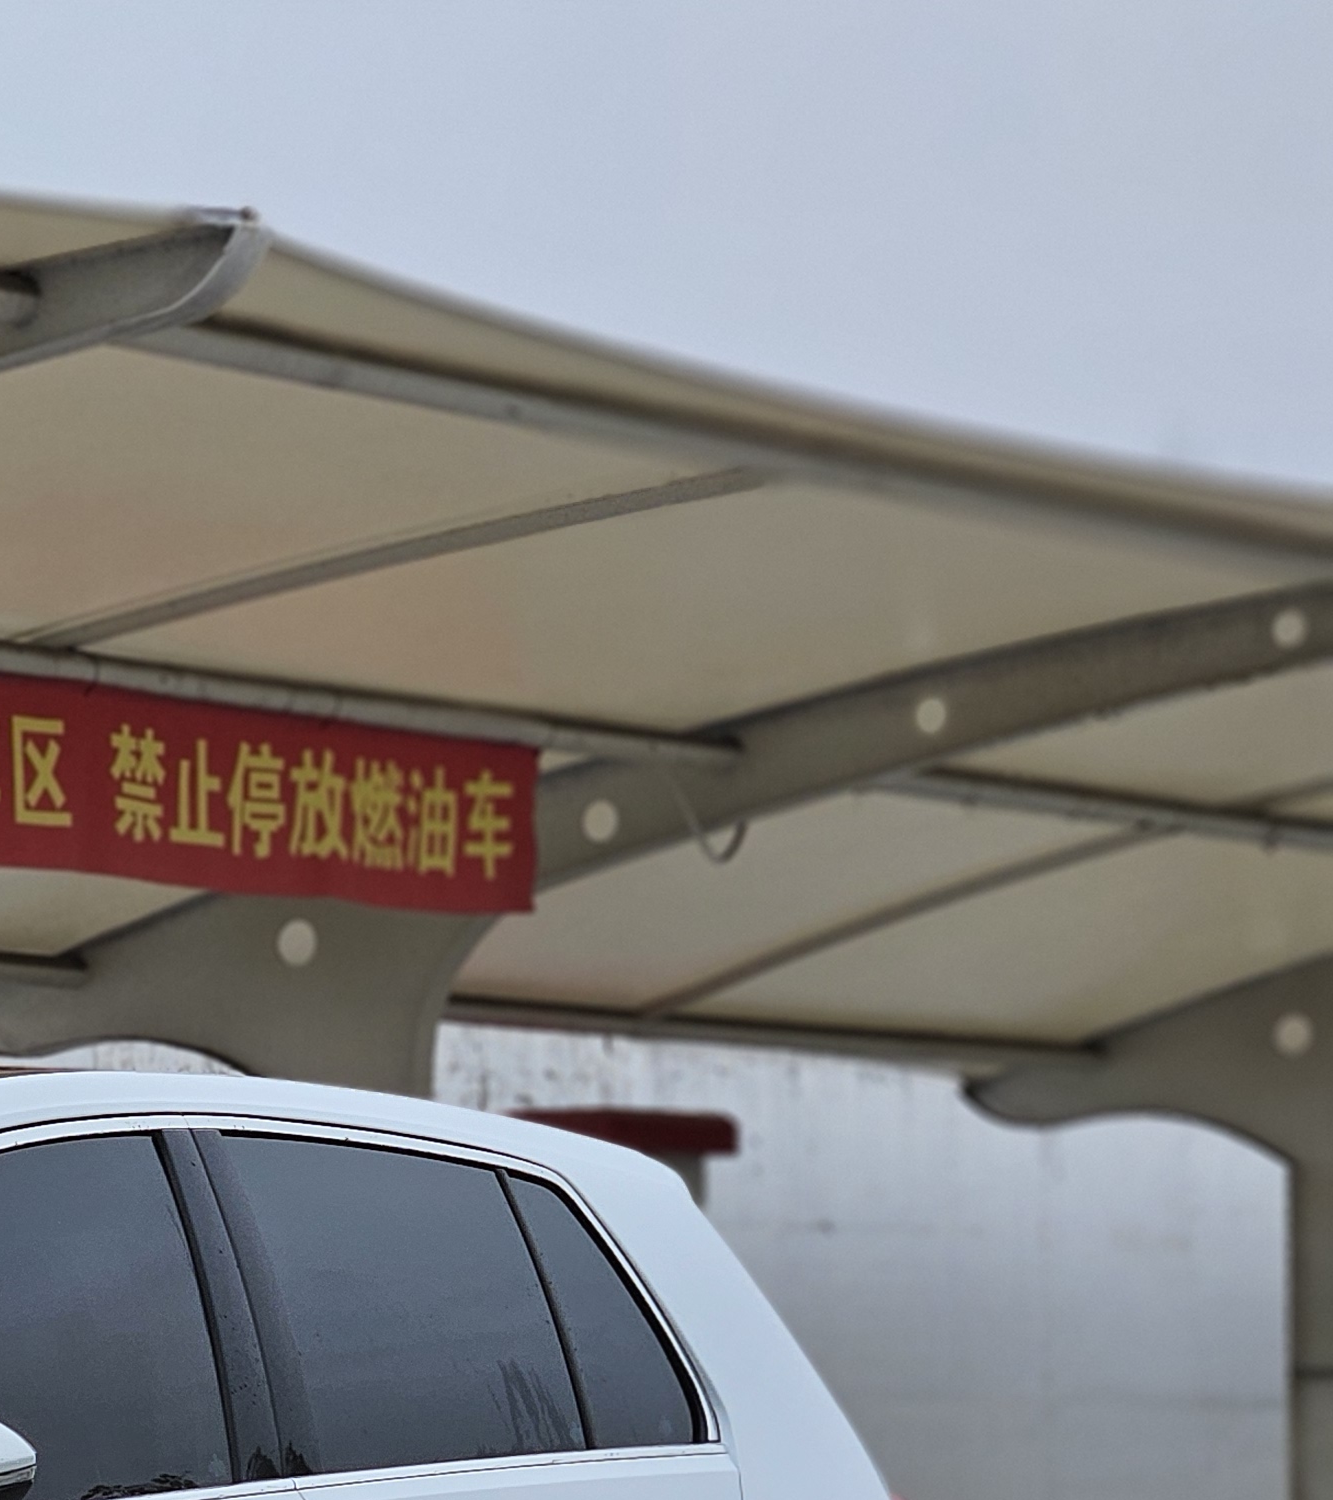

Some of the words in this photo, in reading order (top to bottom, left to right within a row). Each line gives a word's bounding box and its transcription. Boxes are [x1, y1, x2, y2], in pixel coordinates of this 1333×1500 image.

[110, 723, 514, 880] 禁止停放燃油车
